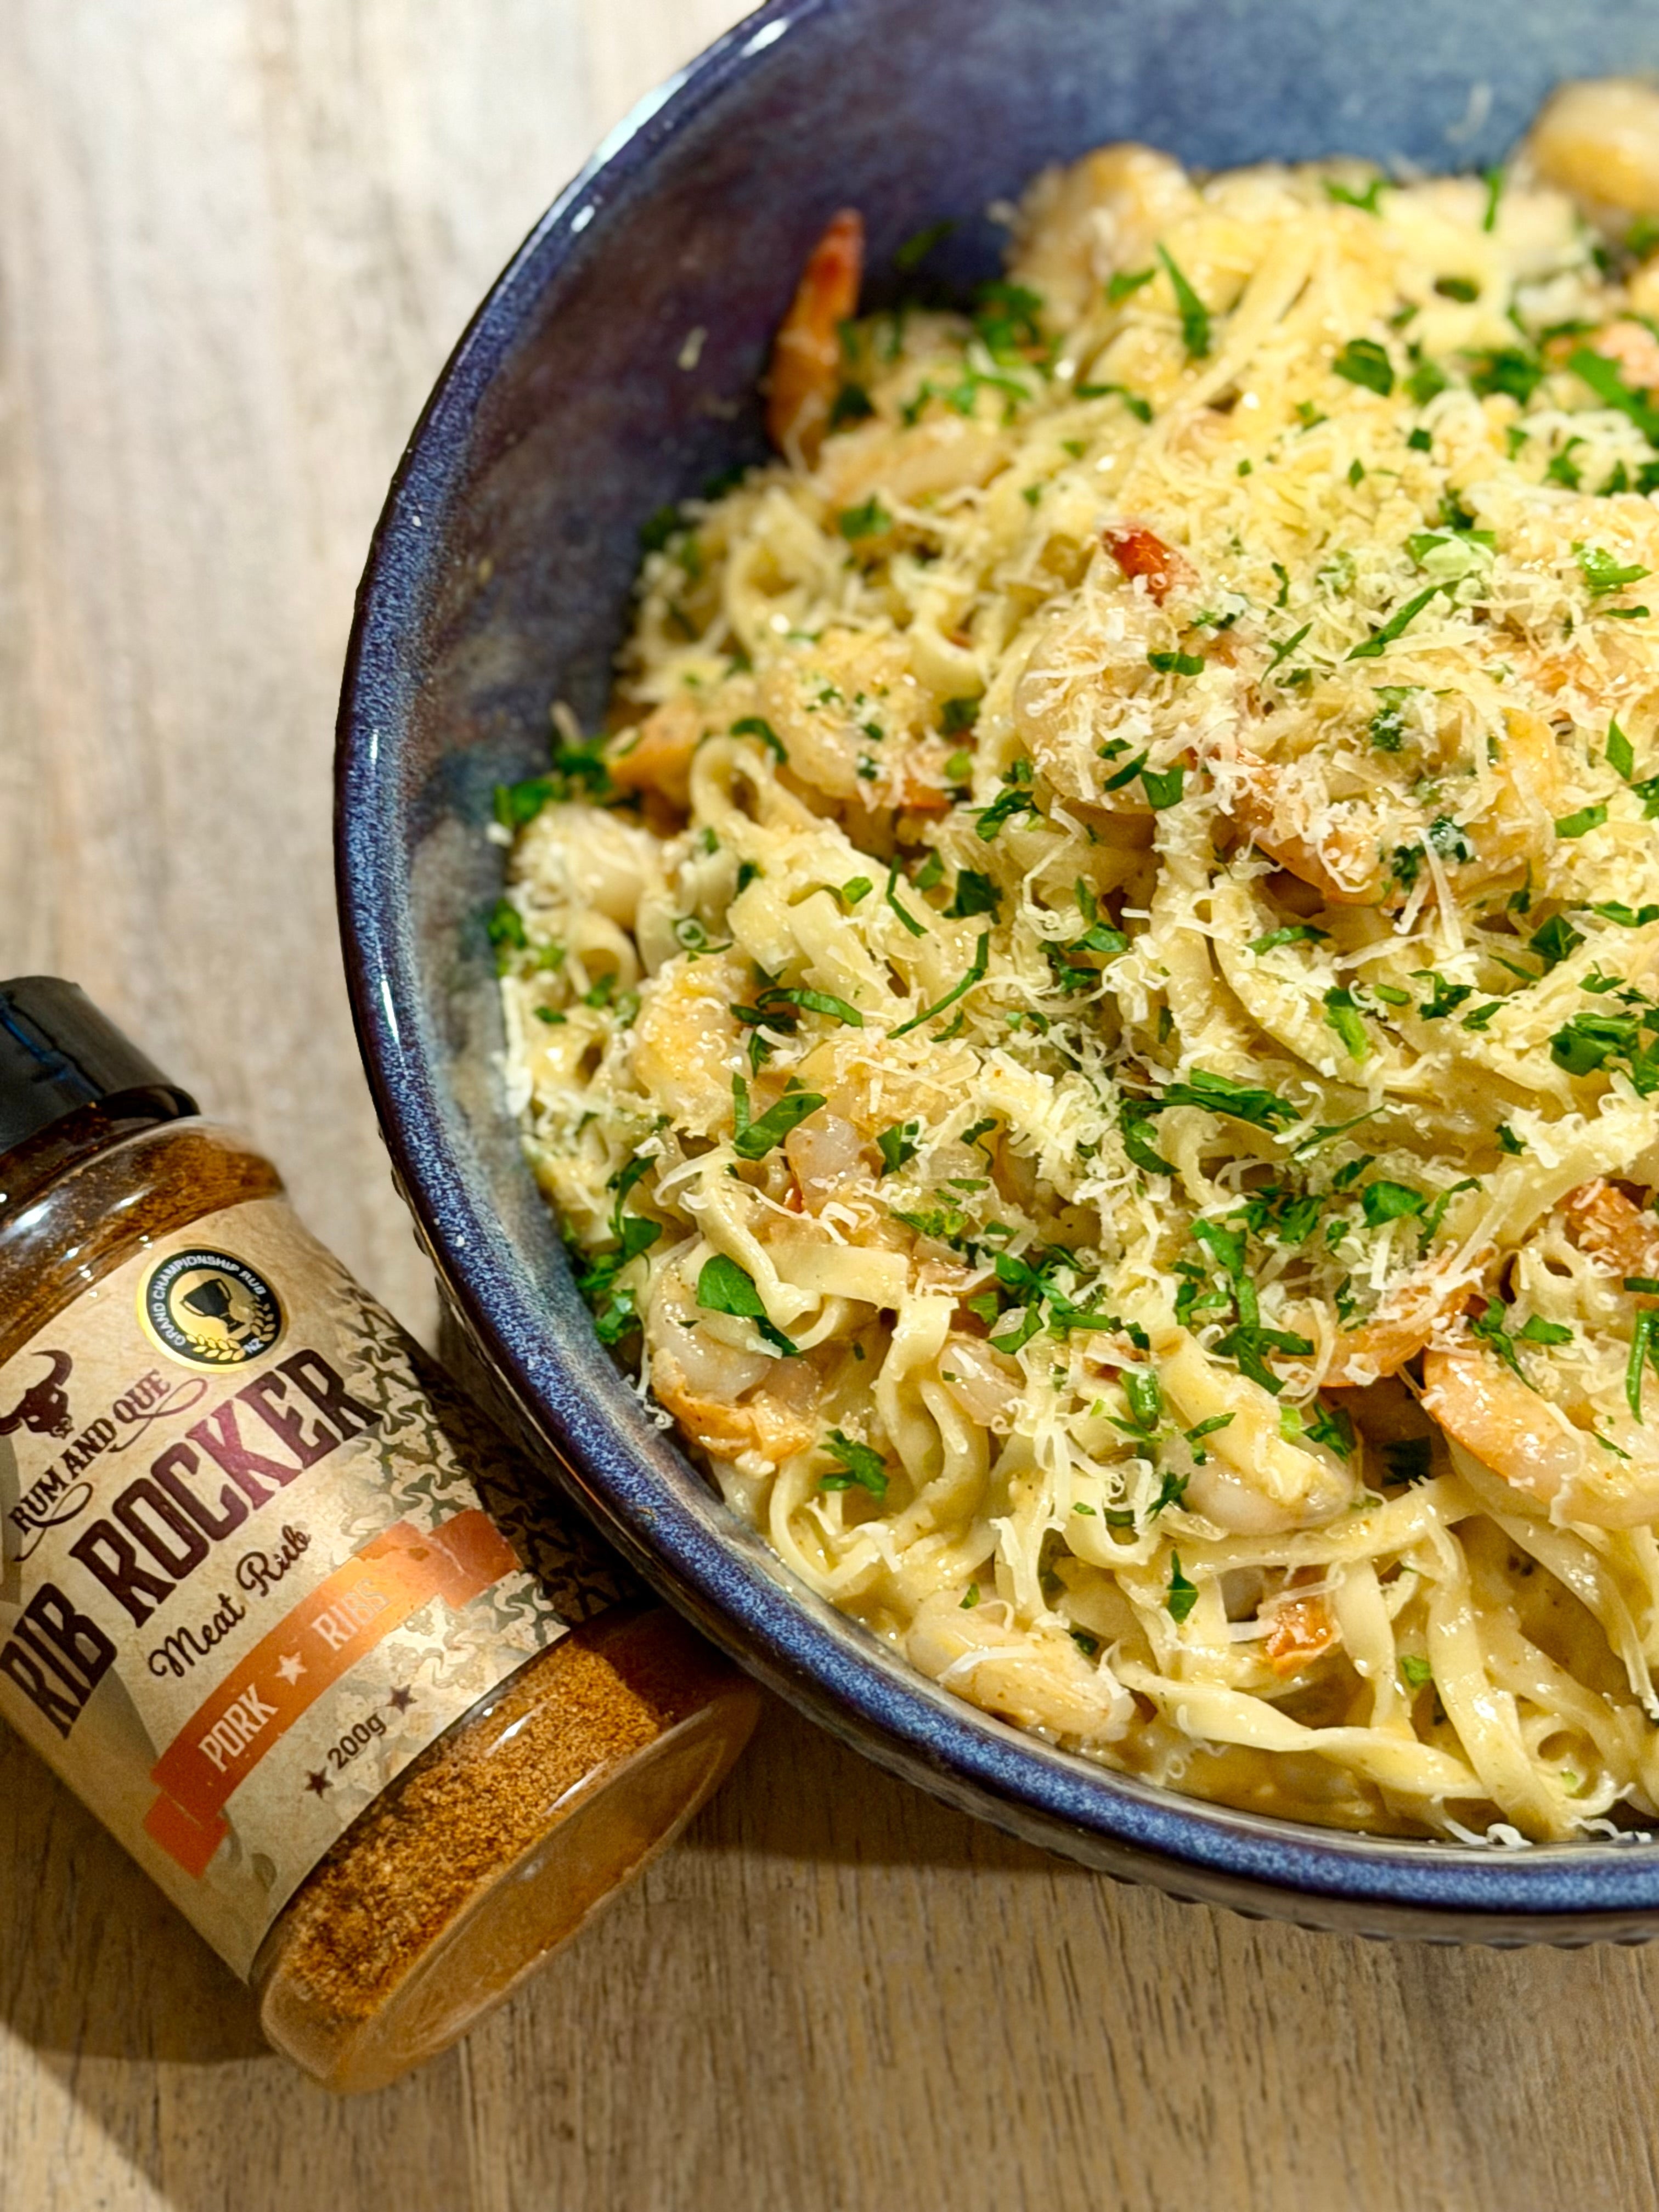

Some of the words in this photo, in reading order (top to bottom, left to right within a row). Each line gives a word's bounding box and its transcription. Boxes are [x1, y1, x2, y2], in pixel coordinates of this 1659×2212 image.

[153, 1255, 240, 1300] CHAMPIONSHIP
[239, 1270, 267, 1295] RUB
[153, 1302, 186, 1346] GRAND
[244, 1338, 264, 1353] NZ
[9, 1465, 93, 1536] RUM
[59, 1418, 117, 1480] AND
[0, 1583, 117, 1740] RIB
[69, 1348, 383, 1628] ROCKER
[148, 1593, 245, 1678] Meat
[236, 1525, 311, 1597] Rub
[198, 1683, 279, 1773] PORK
[311, 1577, 390, 1651] RIBS
[326, 1712, 387, 1770] 200g
